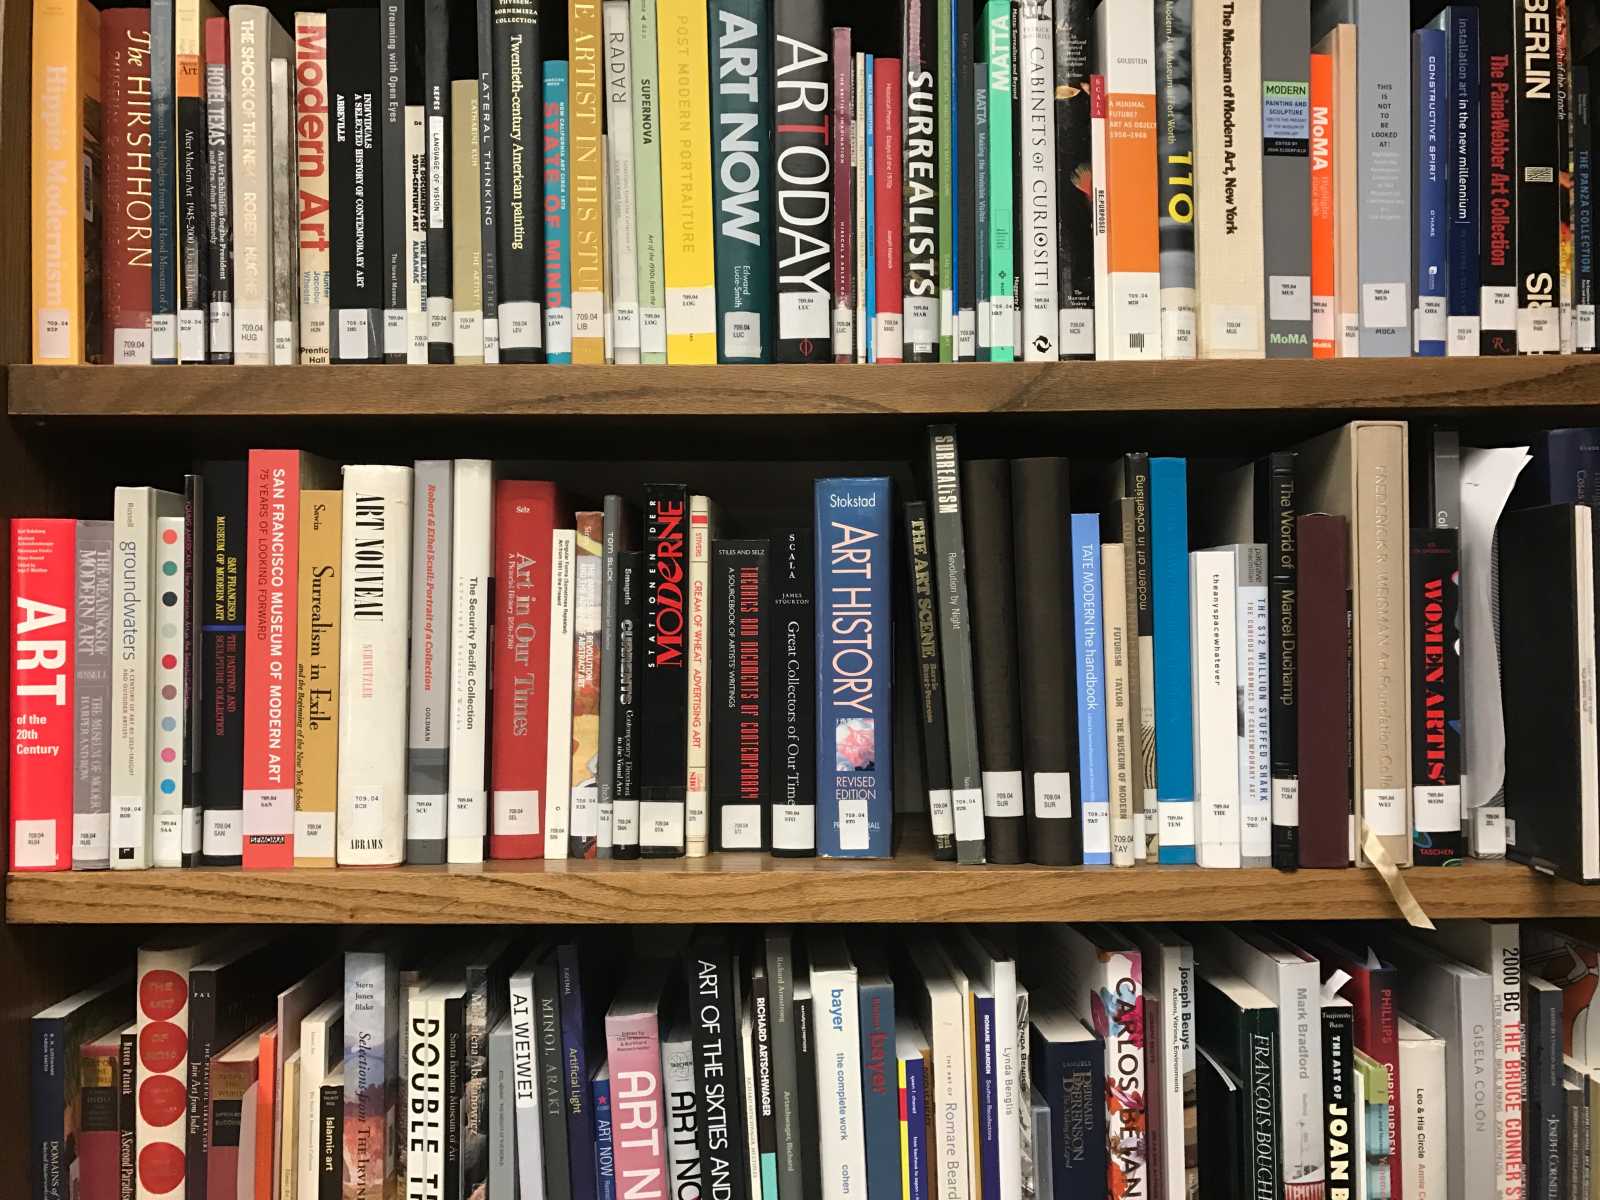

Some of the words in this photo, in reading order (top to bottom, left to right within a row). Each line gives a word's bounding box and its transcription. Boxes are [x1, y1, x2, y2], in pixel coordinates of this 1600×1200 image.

[388, 6, 397, 49] Dreaming
[1222, 2, 1234, 26] The
[127, 30, 151, 67] The
[389, 52, 397, 73] with
[609, 32, 627, 104] RADAR
[719, 11, 758, 102] ART
[991, 14, 1010, 92] MATTA
[1223, 29, 1234, 82] Museum
[1491, 54, 1509, 78] The
[1525, 0, 1551, 99] BERLIN
[388, 75, 398, 99] Open
[510, 34, 522, 140] Twentieth-century
[575, 28, 596, 125] ARTIST
[1223, 85, 1235, 97] of
[1266, 85, 1306, 95] MODERN
[297, 26, 328, 177] Modern
[364, 93, 372, 149] INDIVIDUALS
[389, 102, 398, 123] Eyes
[482, 73, 490, 143] LATERAL
[641, 79, 652, 145] SUPERNOVA
[355, 102, 363, 146] SELECTED
[1224, 100, 1235, 148] Modern
[1313, 106, 1328, 171] MoMA
[1491, 83, 1508, 170] PaineWebber
[355, 148, 363, 184] HISTORY
[576, 135, 597, 162] IN
[1223, 151, 1236, 175] Art,
[127, 77, 152, 267] HIRSHHORN
[484, 151, 492, 226] THINKING
[512, 144, 524, 199] American
[720, 113, 761, 246] NOW
[908, 71, 935, 295] SURREALISTS
[1168, 151, 1193, 224] 110
[1225, 178, 1236, 204] New
[1491, 173, 1508, 194] Art
[355, 186, 363, 197] OF
[576, 174, 597, 228] HIS
[300, 190, 330, 252] Art
[355, 198, 364, 268] CONTEMPORARY
[511, 202, 524, 249] painting
[1226, 206, 1237, 235] York
[1491, 198, 1509, 265] Collection
[356, 270, 364, 288] ART
[735, 266, 743, 308] Lucie-Smith
[743, 265, 751, 295] Edward
[576, 313, 598, 321] 709.04
[124, 341, 145, 349] 709.04
[1270, 334, 1308, 344] MoMA
[272, 469, 285, 498] SAN
[830, 493, 876, 509] Stokstad
[1280, 482, 1294, 506] The
[313, 504, 325, 530] Sawin
[355, 492, 385, 530] ART
[271, 504, 284, 587] FRANCISCO
[832, 522, 880, 579] ART
[1280, 510, 1294, 552] World
[516, 553, 536, 589] Art
[1083, 544, 1093, 569] TATE
[1281, 556, 1295, 569] of
[120, 541, 141, 660] groundwaters
[354, 538, 384, 624] NOUVEAU
[469, 577, 478, 596] The
[694, 580, 703, 613] CREAM
[1083, 572, 1095, 625] MODERN
[271, 592, 283, 656] MUSEUM
[310, 566, 334, 656] Surrealism
[467, 599, 477, 640] Security
[516, 595, 536, 615] in
[694, 616, 703, 626] OF
[1281, 590, 1295, 636] Marcel
[515, 623, 535, 666] Our
[694, 631, 703, 663] WHEAT
[1085, 627, 1096, 647] the
[1114, 627, 1122, 666] FUTURISM
[1213, 574, 1221, 686] theanyspacewhatever
[1425, 579, 1444, 683] WOMEN
[17, 597, 66, 705] ART
[467, 643, 477, 676] Pacific
[832, 588, 873, 713] HISTORY
[271, 661, 283, 680] OF
[310, 664, 328, 680] in
[1085, 650, 1097, 709] handbook
[1280, 641, 1295, 705] Duchamp
[309, 689, 333, 730] Exile
[467, 679, 476, 730] Collection
[513, 672, 535, 736] Times
[693, 669, 702, 727] ADVERTISING
[1115, 678, 1123, 707] TAYLOR
[17, 715, 26, 724] of
[29, 715, 47, 724] the
[17, 730, 38, 740] 20th
[270, 685, 282, 748] MODERN
[17, 744, 59, 755] Century
[692, 730, 702, 748] ART
[269, 753, 281, 783] ART
[836, 776, 876, 788] REVISED
[835, 789, 877, 800] EDITION
[351, 839, 383, 850] ABRAMS
[1114, 844, 1129, 853] TAY
[1419, 848, 1454, 856] TASCHEN
[698, 960, 719, 999] ART
[1502, 948, 1520, 985] 2000
[513, 994, 529, 1015] AI
[1179, 967, 1191, 1008] Joseph
[1503, 992, 1520, 1012] BC
[701, 1005, 720, 1034] OF
[828, 989, 844, 1031] bayer
[1115, 977, 1139, 1091] CARLOS
[1180, 1013, 1191, 1050] Beuys
[1332, 1036, 1341, 1056] THE
[1504, 1021, 1520, 1052] THE
[515, 1023, 533, 1099] WEIWEI
[703, 1039, 723, 1078] THE
[836, 1053, 845, 1068] the
[1332, 1060, 1342, 1082] ART
[411, 1018, 440, 1153] DOUBLE
[836, 1070, 847, 1114] complete
[1333, 1085, 1342, 1100] OF
[1504, 1061, 1521, 1112] BRUCE
[617, 1071, 660, 1156] ART
[705, 1084, 728, 1149] SIXTIES
[840, 1117, 849, 1140] work
[326, 1117, 335, 1153] Islamic
[1329, 1103, 1349, 1180] JOAN
[1505, 1118, 1522, 1181] CONNER
[326, 1157, 334, 1171] art
[711, 1157, 731, 1200] AND
[842, 1164, 851, 1193] cohen
